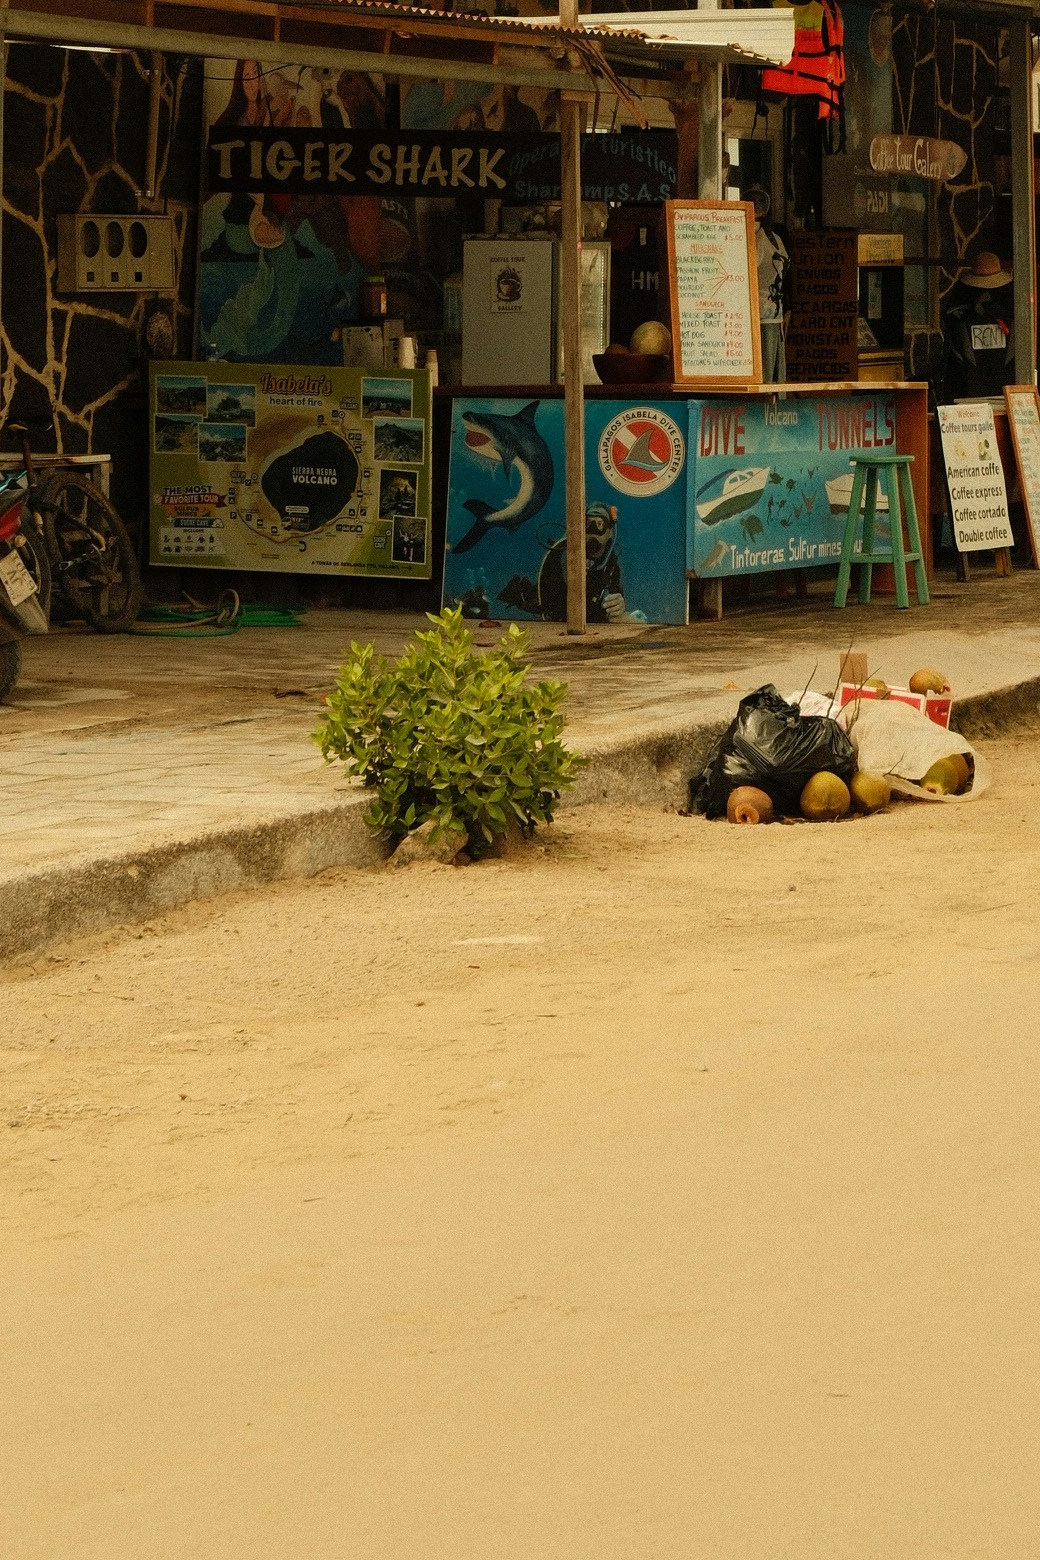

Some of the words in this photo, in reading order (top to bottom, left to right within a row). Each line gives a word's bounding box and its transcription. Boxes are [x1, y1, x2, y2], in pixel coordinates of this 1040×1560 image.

[870, 138, 895, 172] Coffee
[894, 138, 914, 171] Tour
[211, 139, 357, 182] TIGER
[366, 143, 507, 190] SHARK
[797, 269, 841, 279] ENVIOS
[797, 285, 839, 295] PAGOS
[791, 301, 858, 313] ECARGAS
[702, 311, 723, 320] TOAST
[703, 319, 721, 328] TOAST
[830, 316, 855, 328] CNT
[796, 349, 838, 359] PAGOS
[786, 362, 851, 375] SERVICIOS
[260, 373, 333, 397] Isabela's
[269, 396, 294, 406] heart
[296, 397, 307, 406] of
[307, 397, 324, 407] fire
[700, 405, 747, 457] DIVE
[764, 401, 798, 426] Volcano
[816, 400, 896, 452] TUNNELS
[941, 423, 961, 434] Coffee
[961, 424, 978, 433] tours
[602, 419, 623, 472] GALAPAGOS
[622, 411, 658, 423] ISABELA
[659, 417, 678, 436] DIVE
[669, 437, 682, 474] CENTER
[292, 467, 315, 475] SIERRA
[316, 467, 337, 476] NEGRA
[947, 466, 980, 479] American
[292, 475, 338, 485] VOLCANO
[164, 487, 182, 495] THE
[184, 486, 213, 494] MOST
[951, 487, 975, 500] Coffee
[975, 486, 1003, 501] express
[164, 494, 199, 504] FAVORITE
[200, 494, 221, 504] TOUR
[954, 508, 977, 522] Coffee
[978, 506, 1007, 520] cortado
[959, 529, 984, 544] Double
[985, 527, 1008, 541] coffee
[818, 539, 843, 559] mines
